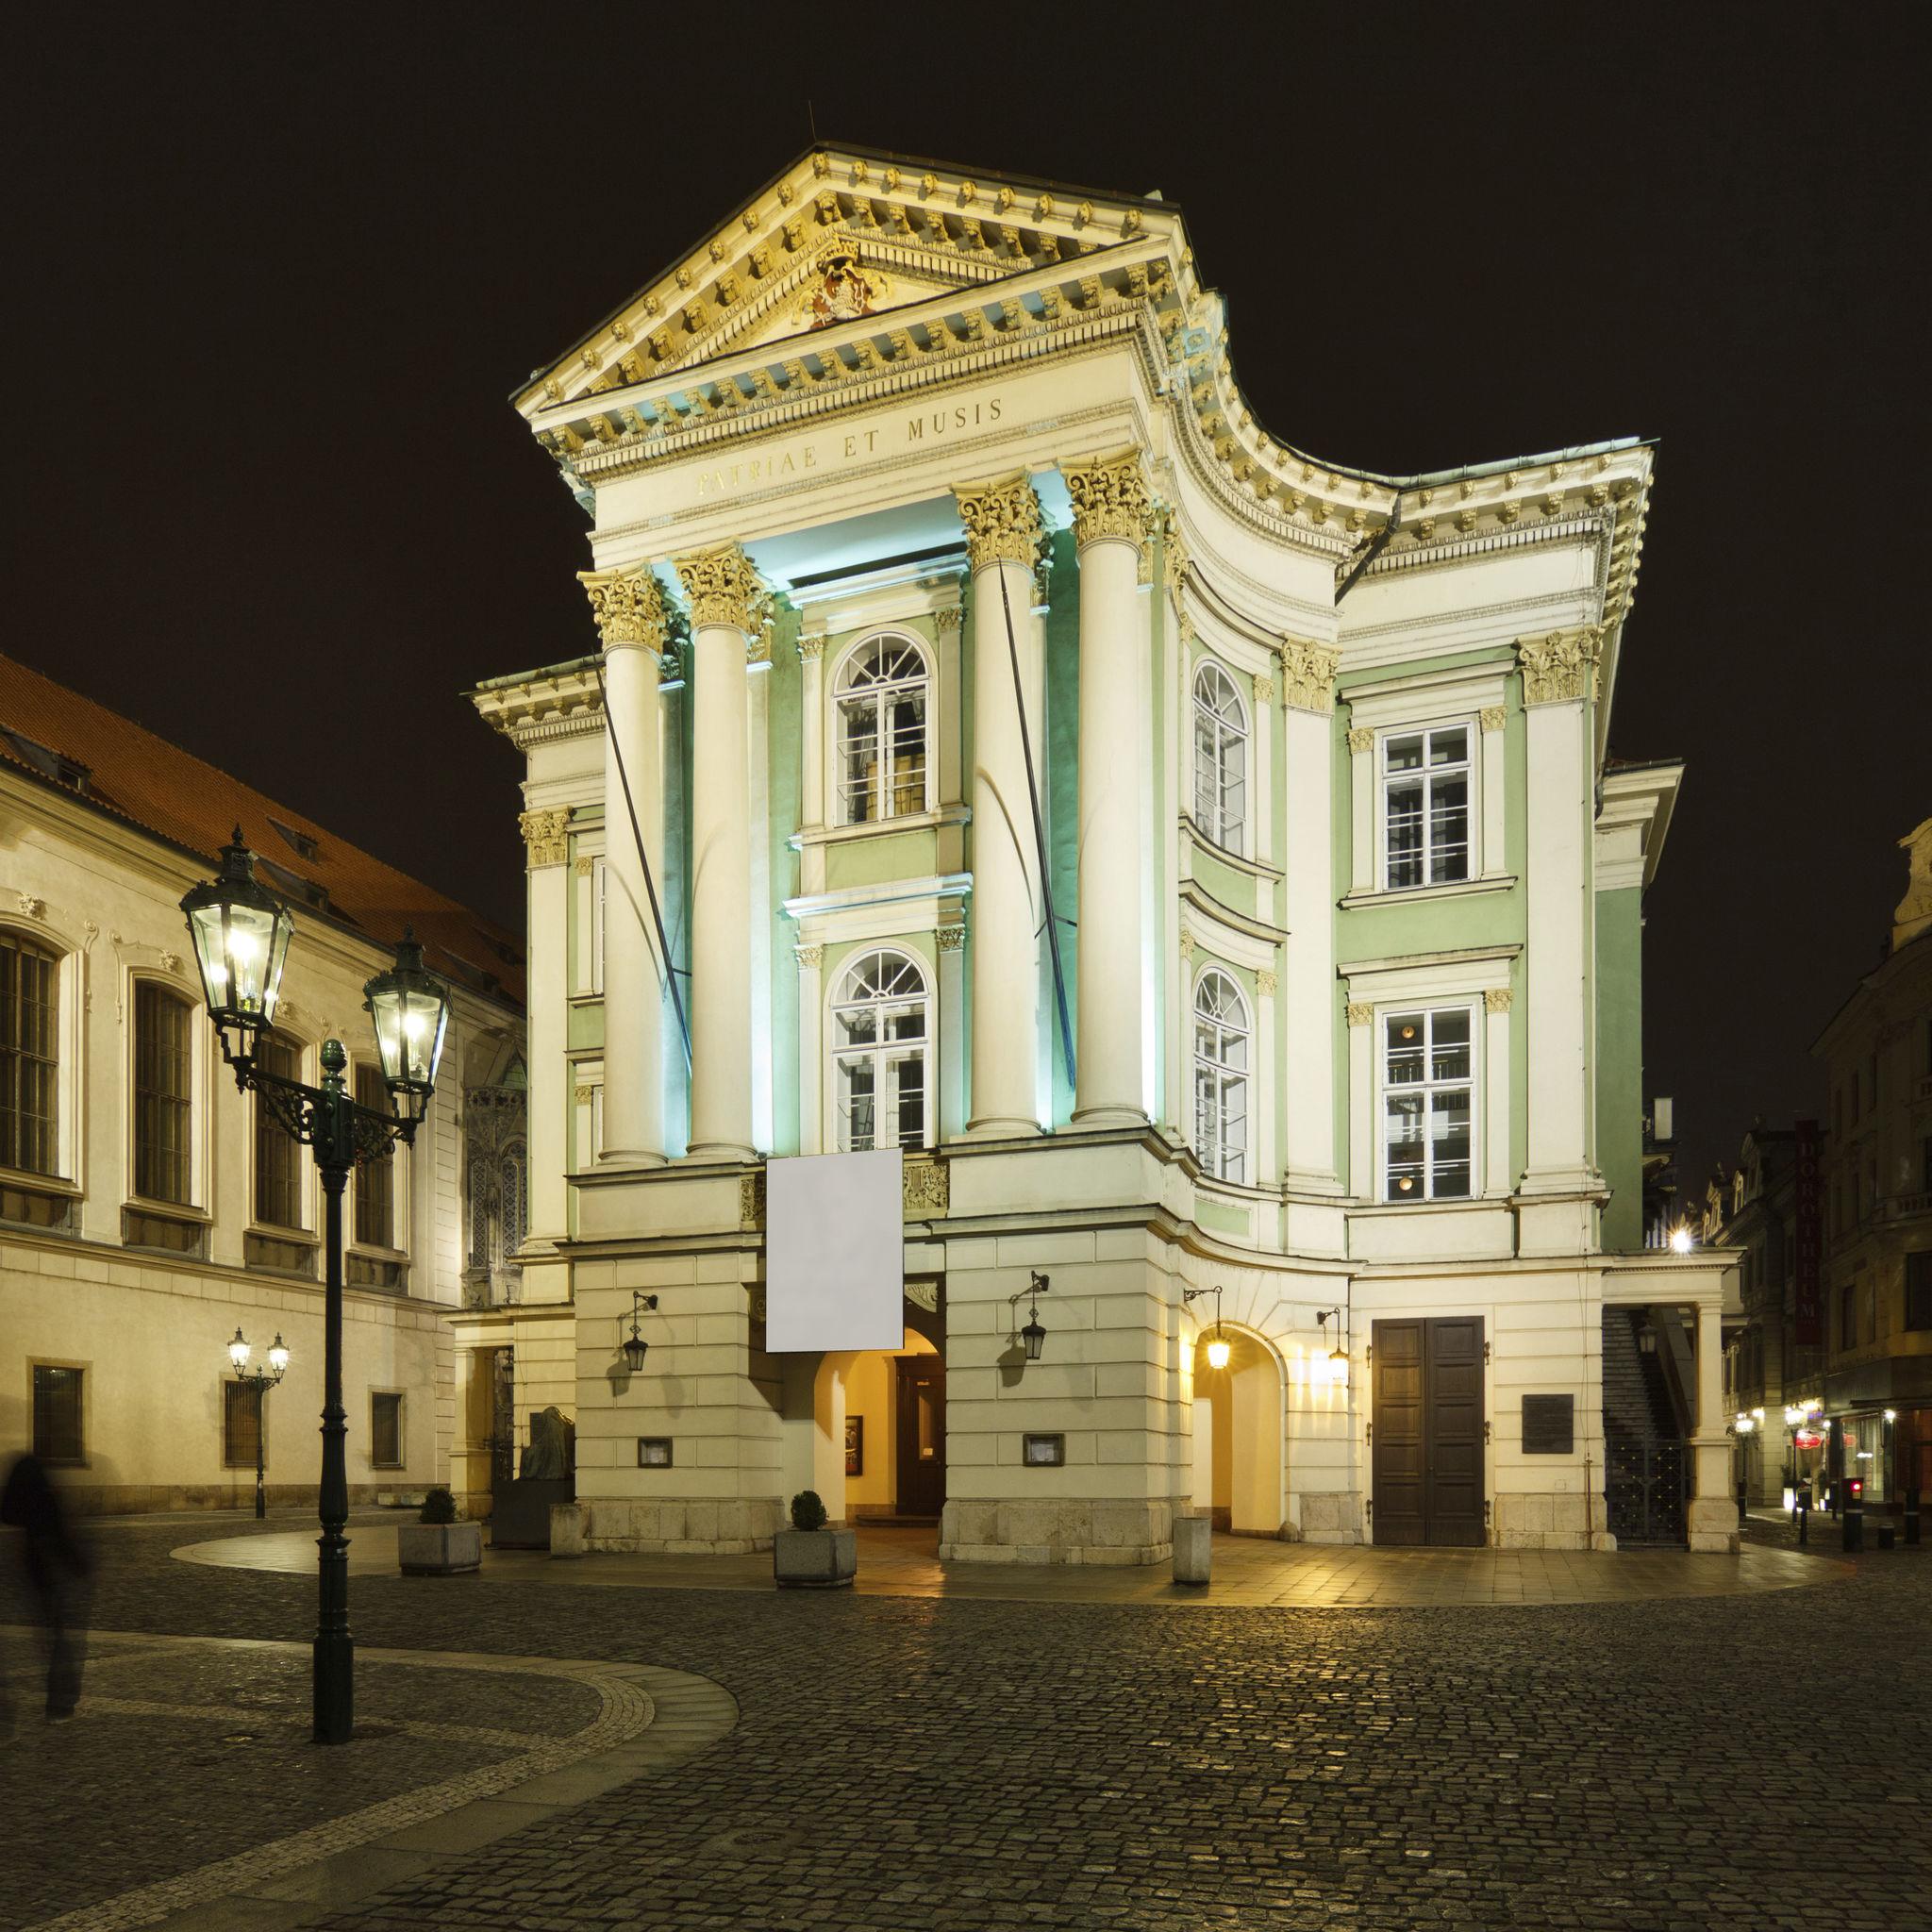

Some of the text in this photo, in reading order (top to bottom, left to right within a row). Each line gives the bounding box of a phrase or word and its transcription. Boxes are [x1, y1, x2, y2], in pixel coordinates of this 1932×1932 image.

[697, 399, 1001, 495] PATRIAE ET MUSIS
